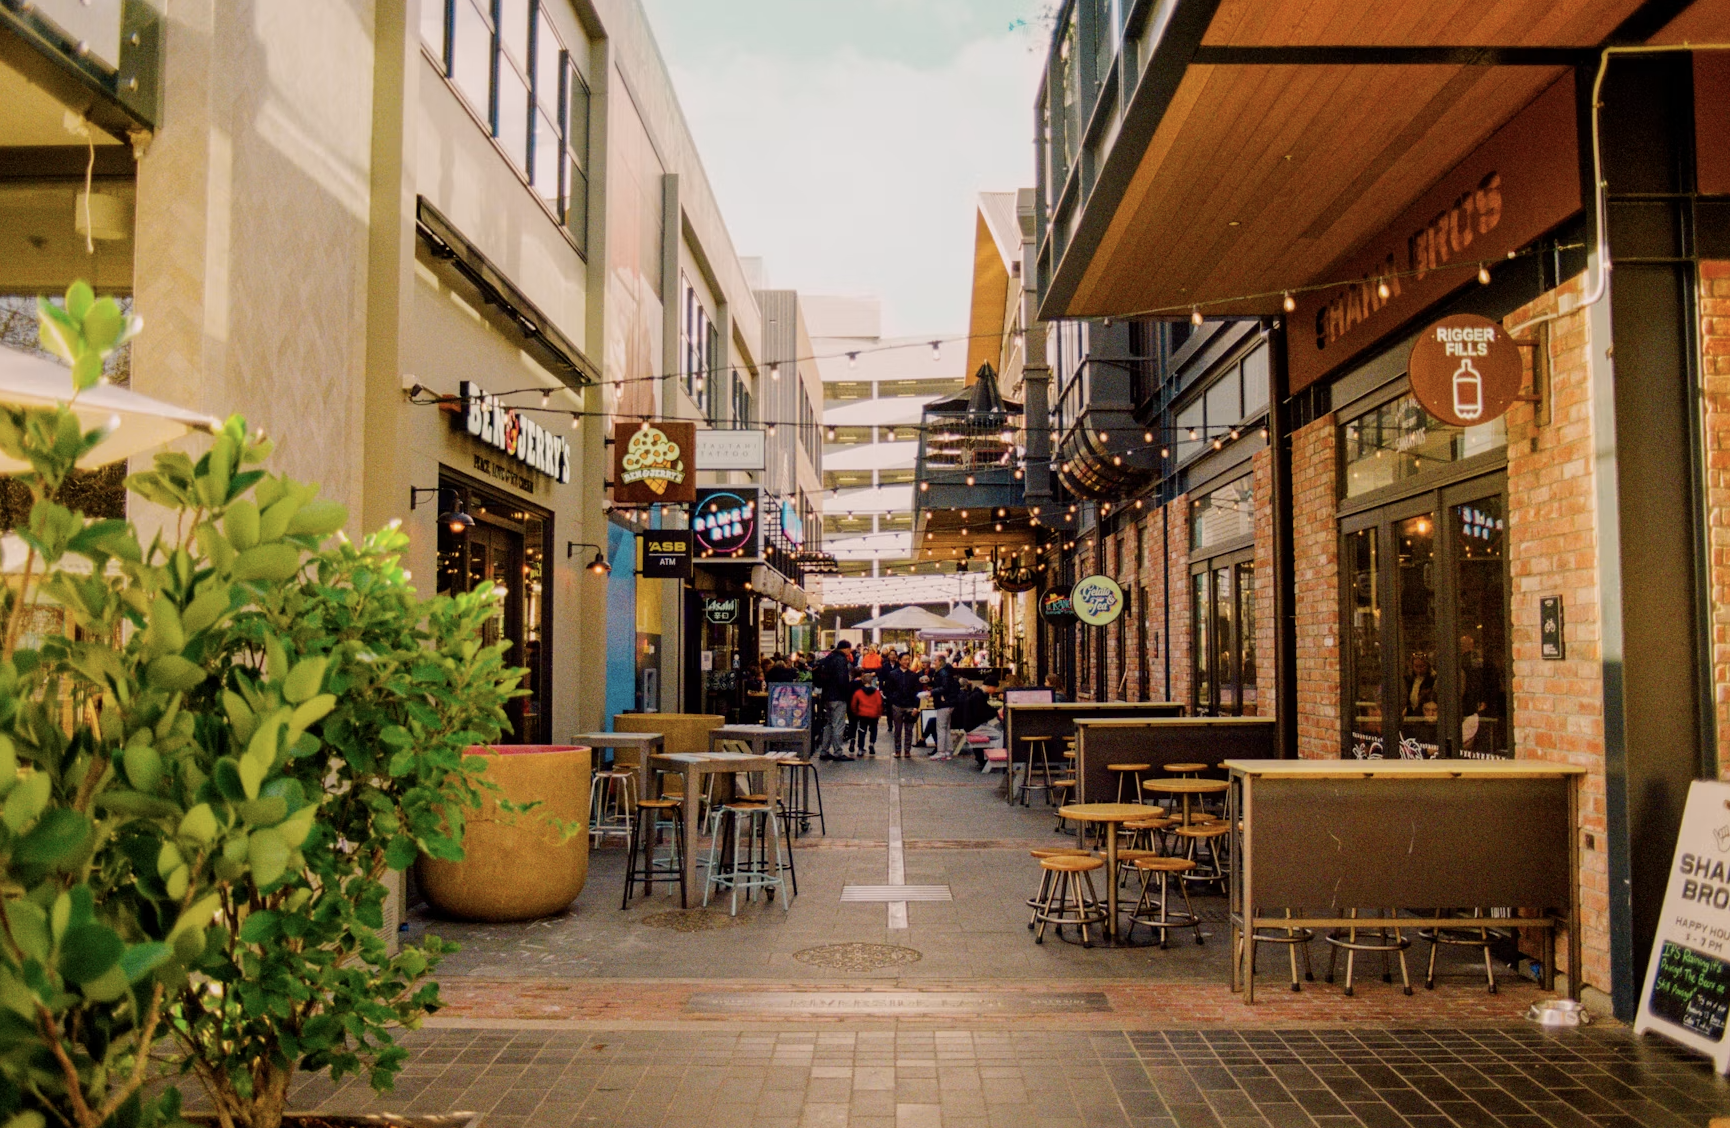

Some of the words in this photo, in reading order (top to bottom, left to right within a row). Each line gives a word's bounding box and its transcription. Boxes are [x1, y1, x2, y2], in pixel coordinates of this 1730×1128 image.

[1436, 327, 1495, 343] RIGGER
[1445, 342, 1488, 357] FILLS
[693, 505, 753, 532] RAMEN
[710, 522, 744, 541] RIA
[659, 557, 676, 566] ATM
[709, 600, 734, 611] Asahi
[1088, 596, 1108, 615] Tea
[1679, 852, 1730, 885] SHA
[1681, 879, 1730, 911] BRO
[1675, 916, 1708, 933] HAPPY
[1708, 941, 1723, 953] PM
